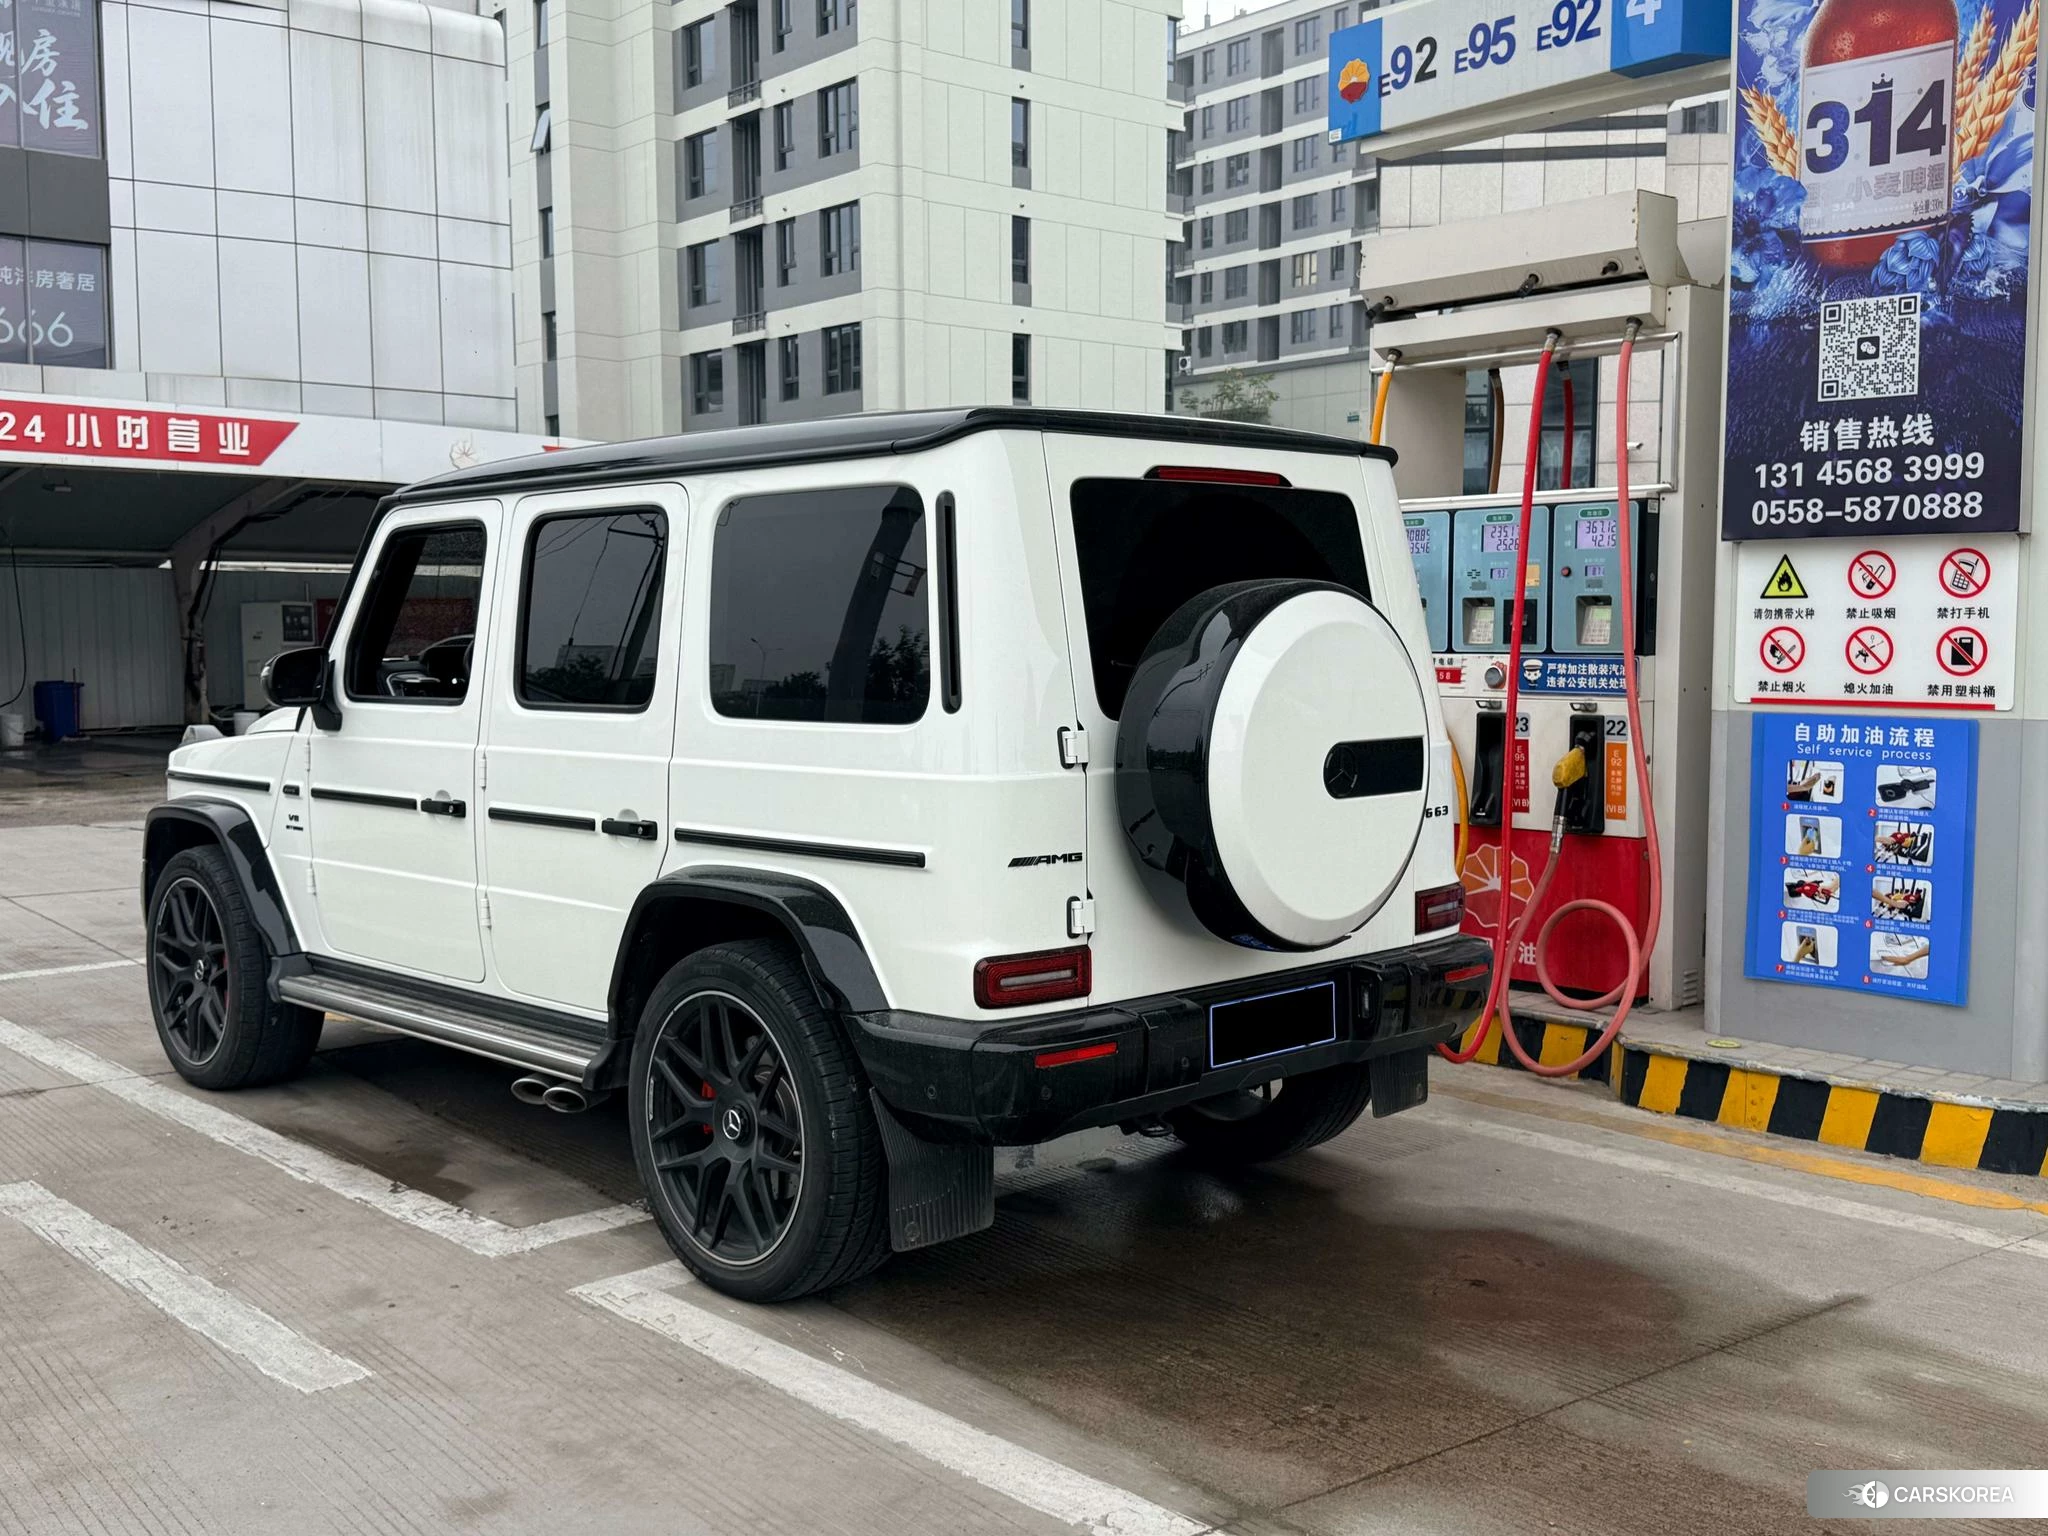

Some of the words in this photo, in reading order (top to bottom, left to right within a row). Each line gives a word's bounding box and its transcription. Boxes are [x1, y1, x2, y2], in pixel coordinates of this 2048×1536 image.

[1378, 36, 1437, 98] E92
[1454, 15, 1517, 74] E95
[1537, 0, 1601, 52] E92
[1805, 79, 1947, 174] 314
[1846, 163, 1946, 201] 小麦啤酒
[0, 411, 46, 443] 24
[66, 413, 250, 456] 小时营业
[1800, 413, 1935, 453] 销售热线
[1755, 462, 1804, 489] 131
[1816, 457, 1893, 486] 4568
[1903, 452, 1985, 482] 3999
[1751, 491, 1984, 526] 0558-5870888
[1753, 608, 1815, 620] 请勿携带火种
[1846, 607, 1896, 620] 禁止吸烟
[1936, 606, 1990, 620] 禁打手机
[1758, 681, 1806, 693] 禁止烟火
[1844, 682, 1894, 695] 熄火加油
[1927, 684, 1996, 698] 禁用塑料桶
[1606, 720, 1627, 736] 22
[1795, 722, 1936, 748] 自助加油流程
[1797, 744, 1820, 755] Self
[1829, 746, 1872, 758] service
[1882, 750, 1931, 760] process
[1032, 852, 1083, 866] AMG
